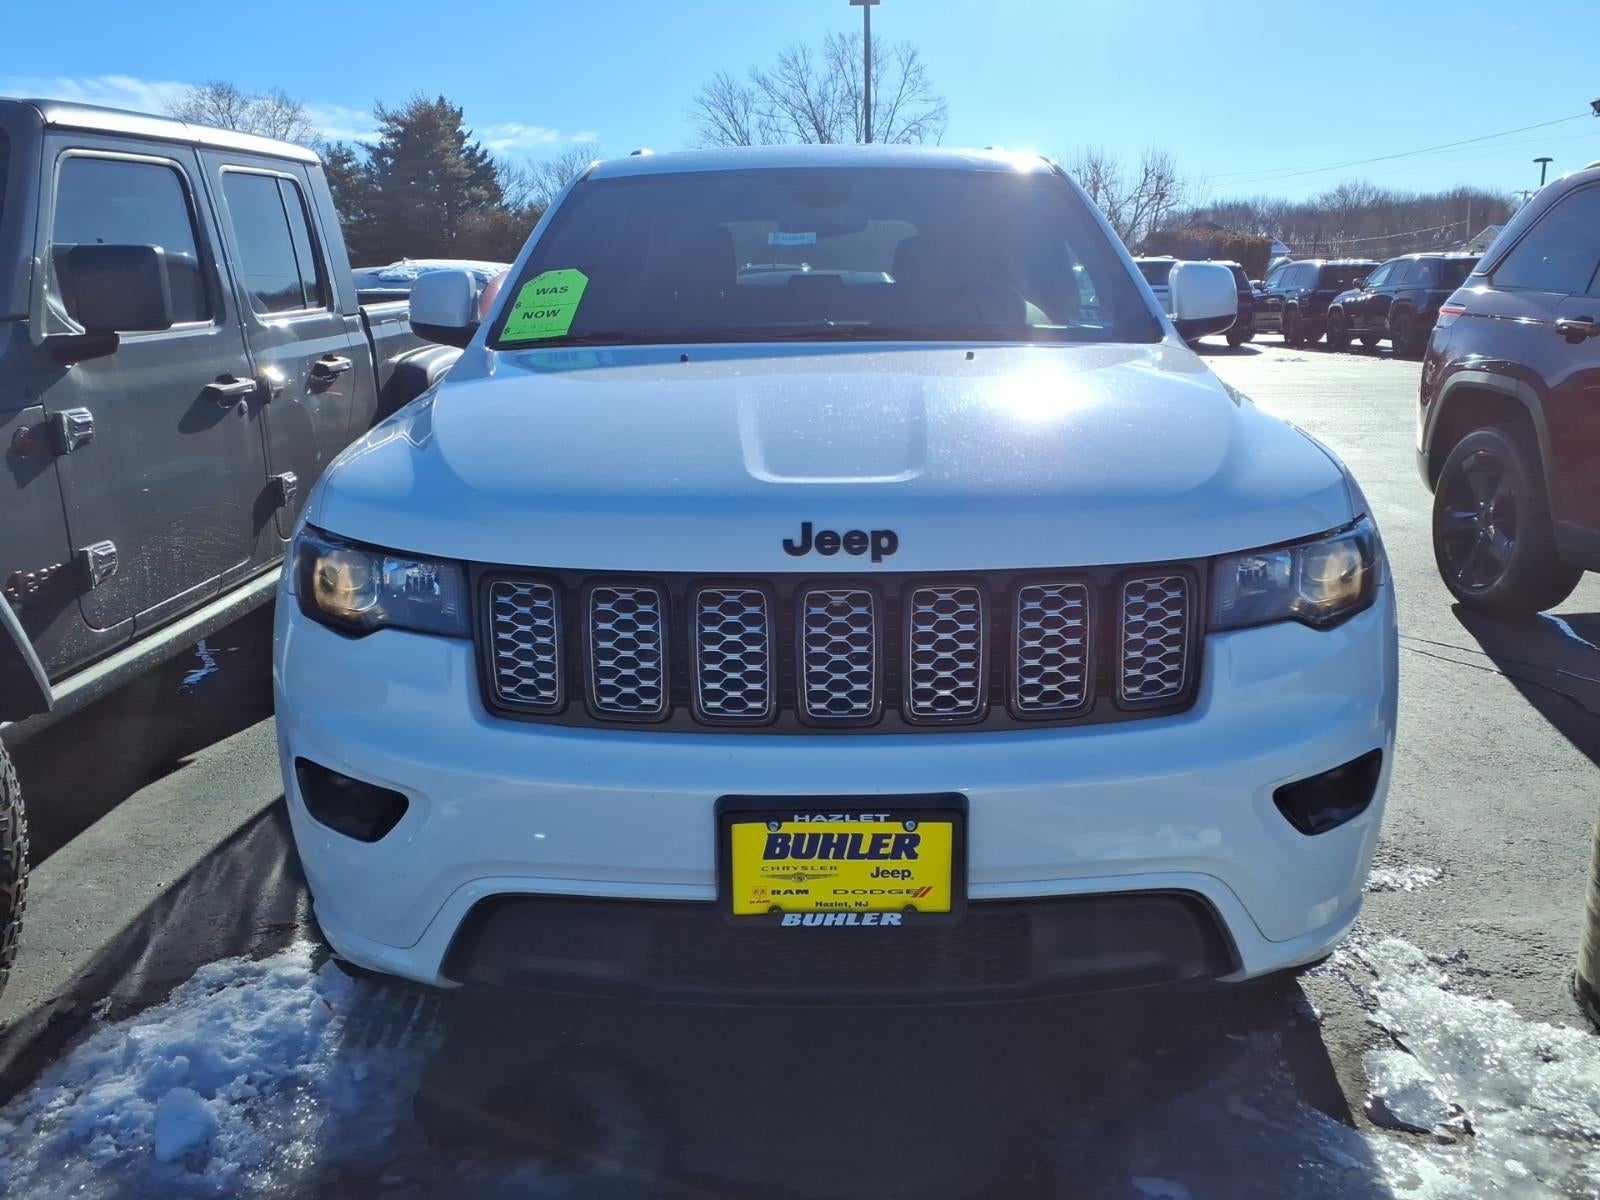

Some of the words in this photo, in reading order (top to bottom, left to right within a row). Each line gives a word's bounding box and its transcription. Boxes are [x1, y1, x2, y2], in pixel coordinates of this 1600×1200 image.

[536, 286, 569, 295] WAS
[522, 309, 560, 319] NOW
[782, 521, 899, 563] Jeep
[794, 814, 890, 823] HAZLET
[763, 833, 921, 860] BUHLER
[870, 866, 912, 880] Jeep
[770, 888, 810, 896] RAM
[815, 900, 852, 908] Hazlet,
[781, 912, 902, 926] BUHLER
